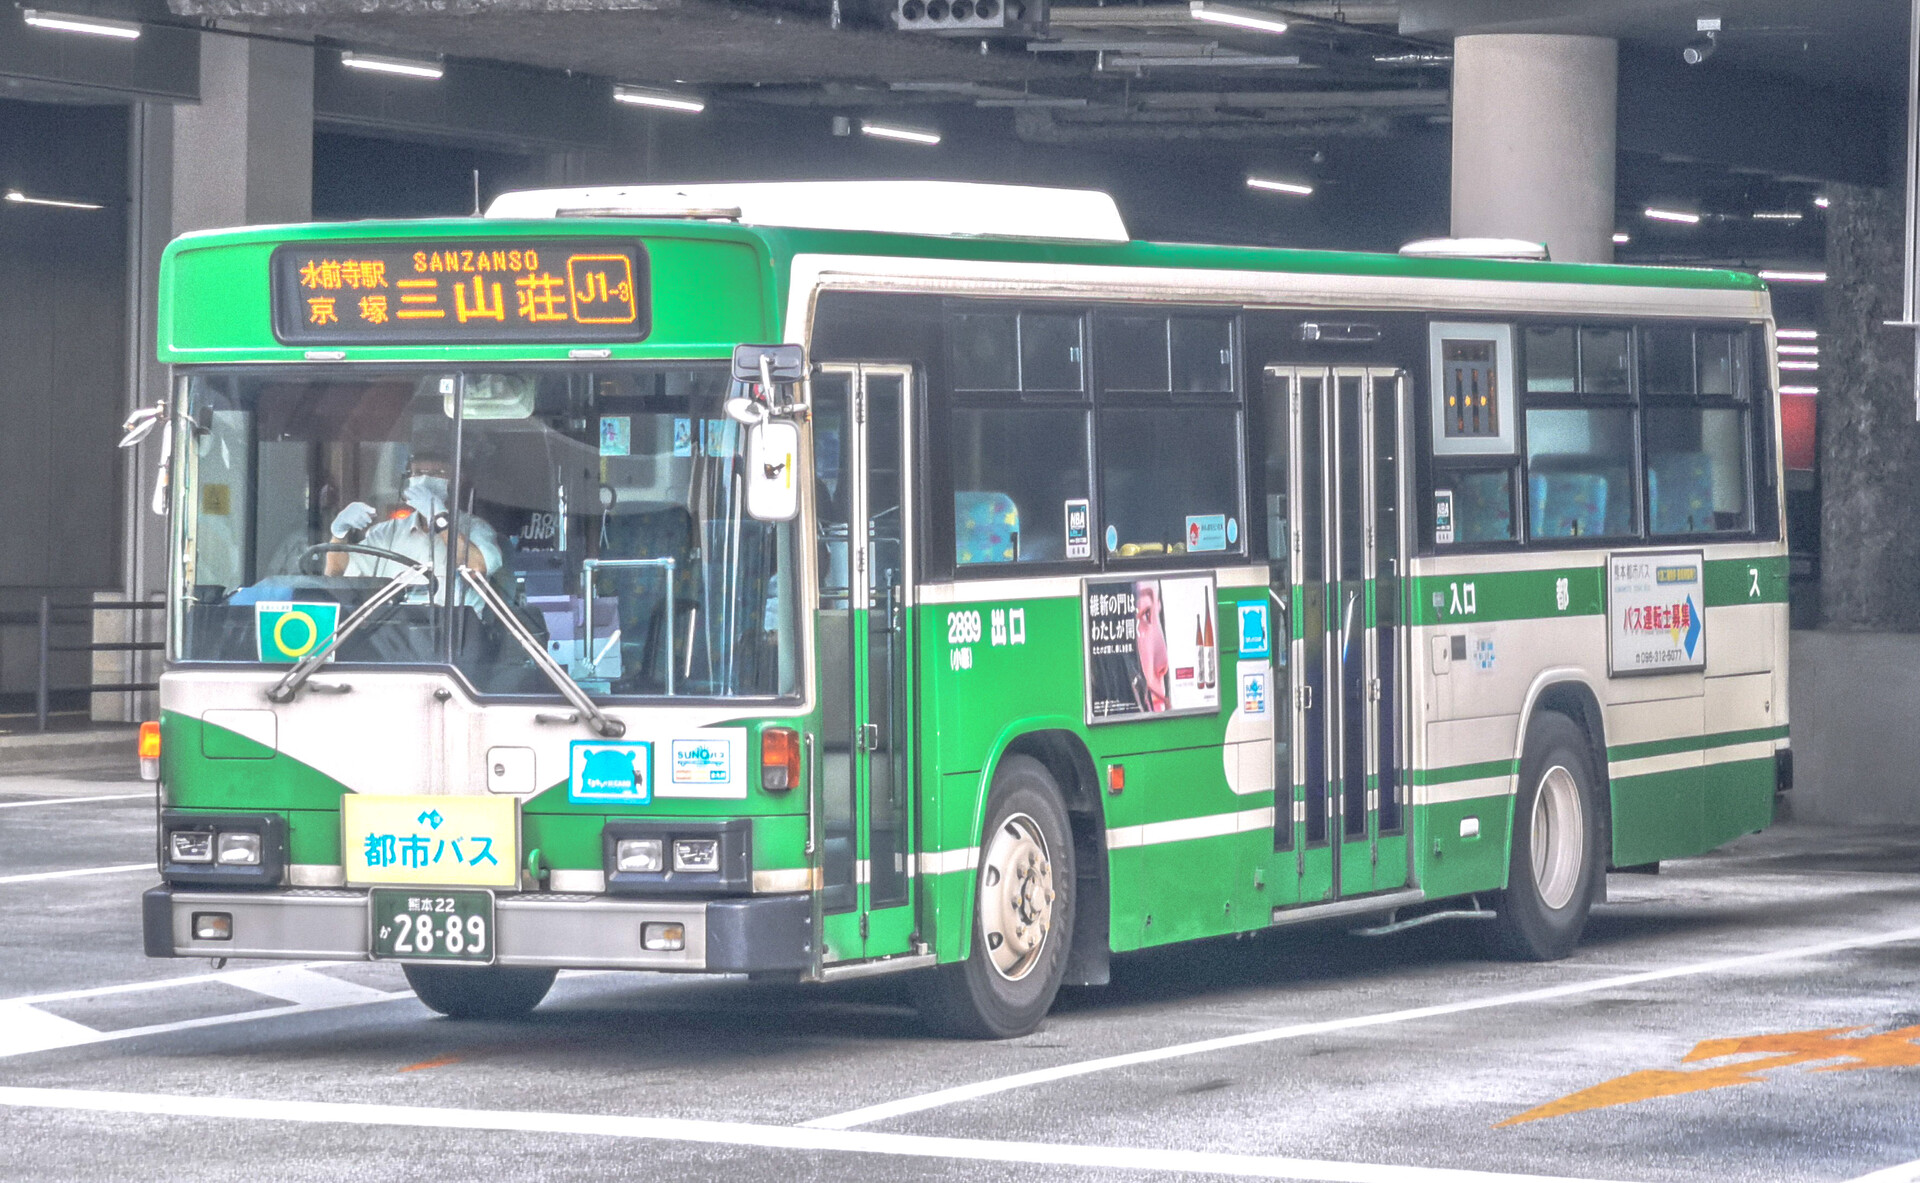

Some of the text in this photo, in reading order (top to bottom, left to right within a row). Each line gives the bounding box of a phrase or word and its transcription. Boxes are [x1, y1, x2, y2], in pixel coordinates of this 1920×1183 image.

[300, 259, 389, 289] 水前寺駅
[413, 250, 539, 273] SANZANSO
[395, 273, 570, 324] 三山荘
[1450, 582, 1476, 615] 入口
[1749, 568, 1760, 598] ス
[947, 609, 982, 644] 2889
[991, 607, 1026, 647] 出口
[1623, 603, 1691, 631] バス運転士募集
[364, 832, 498, 869] 都市バス
[393, 913, 486, 954] 28-89
